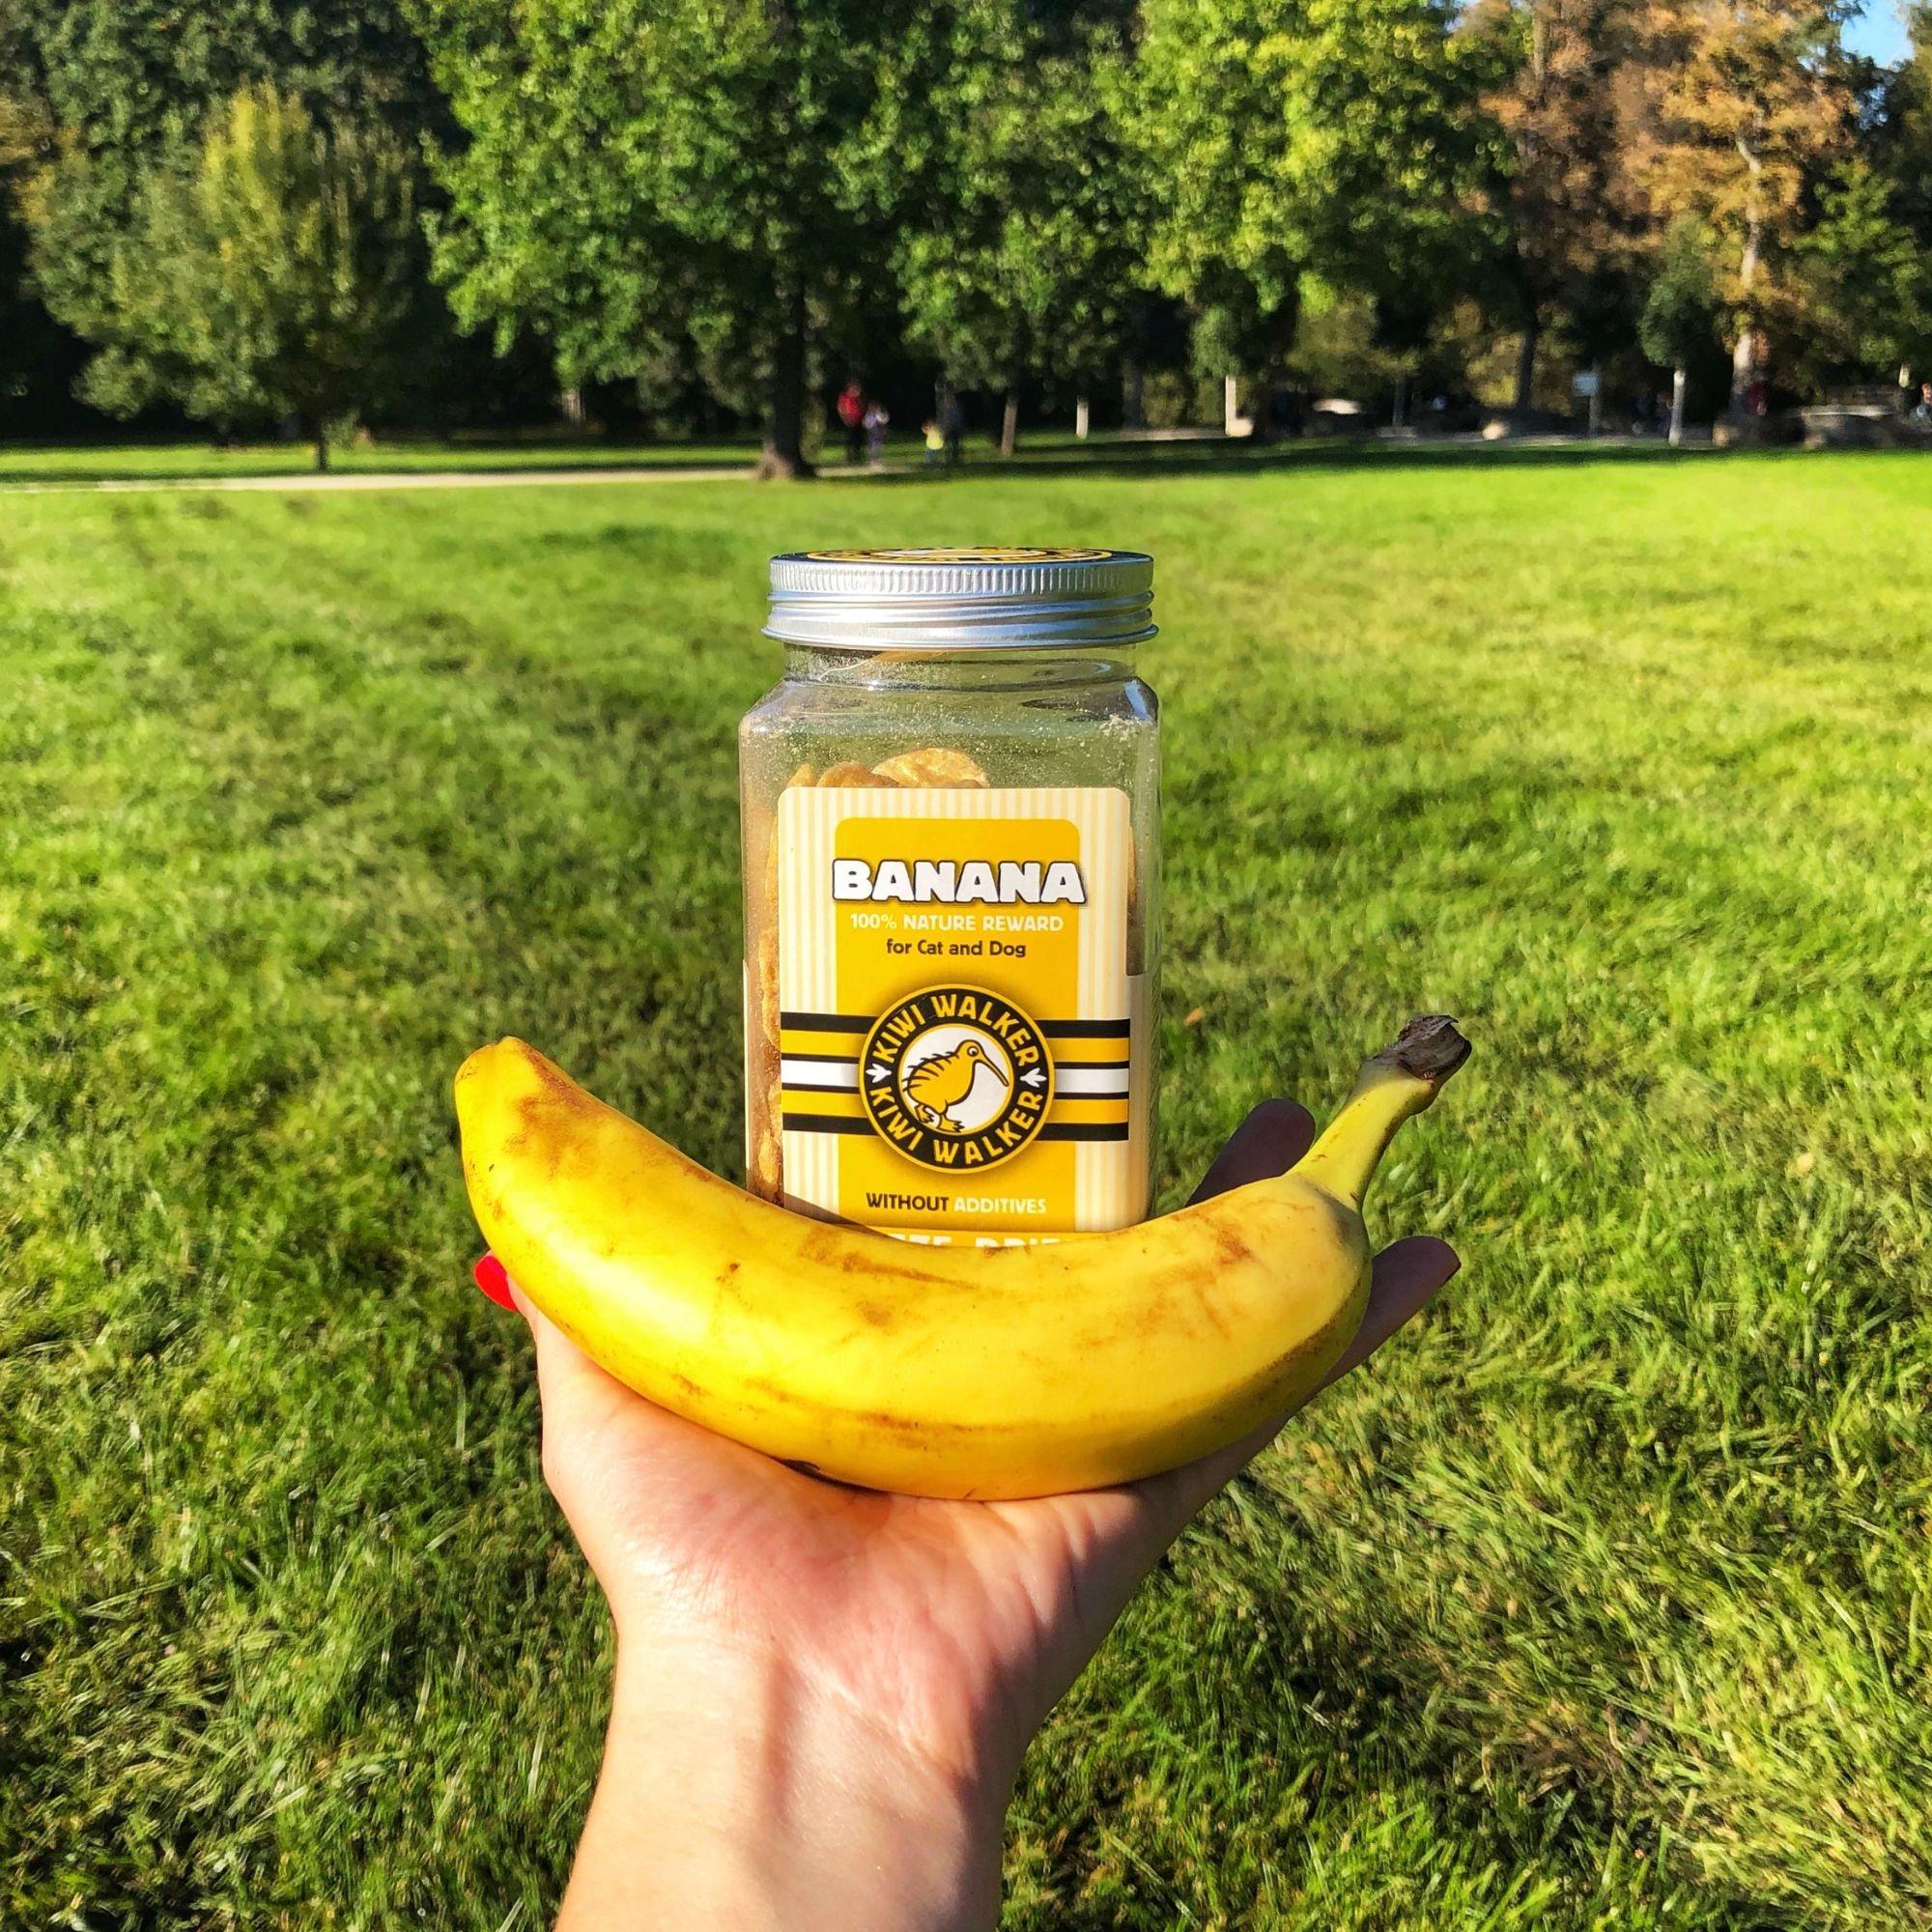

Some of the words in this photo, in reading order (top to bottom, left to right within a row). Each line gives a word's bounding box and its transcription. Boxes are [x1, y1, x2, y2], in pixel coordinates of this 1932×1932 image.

[833, 859, 1086, 904] BANANA
[850, 913, 897, 929] 100%
[903, 914, 976, 931] NATURE
[981, 914, 1064, 932] REWARD
[886, 938, 912, 954] for
[917, 939, 944, 955] Cat
[949, 940, 982, 956] and
[990, 941, 1027, 958] Dog
[872, 1004, 926, 1064] KIWI
[930, 993, 1039, 1066] WALKER
[869, 1086, 923, 1151] KIWI
[933, 1091, 1043, 1164] WALKER
[866, 1192, 949, 1211] WITHOUT
[953, 1196, 1047, 1214] ADDITIVES
